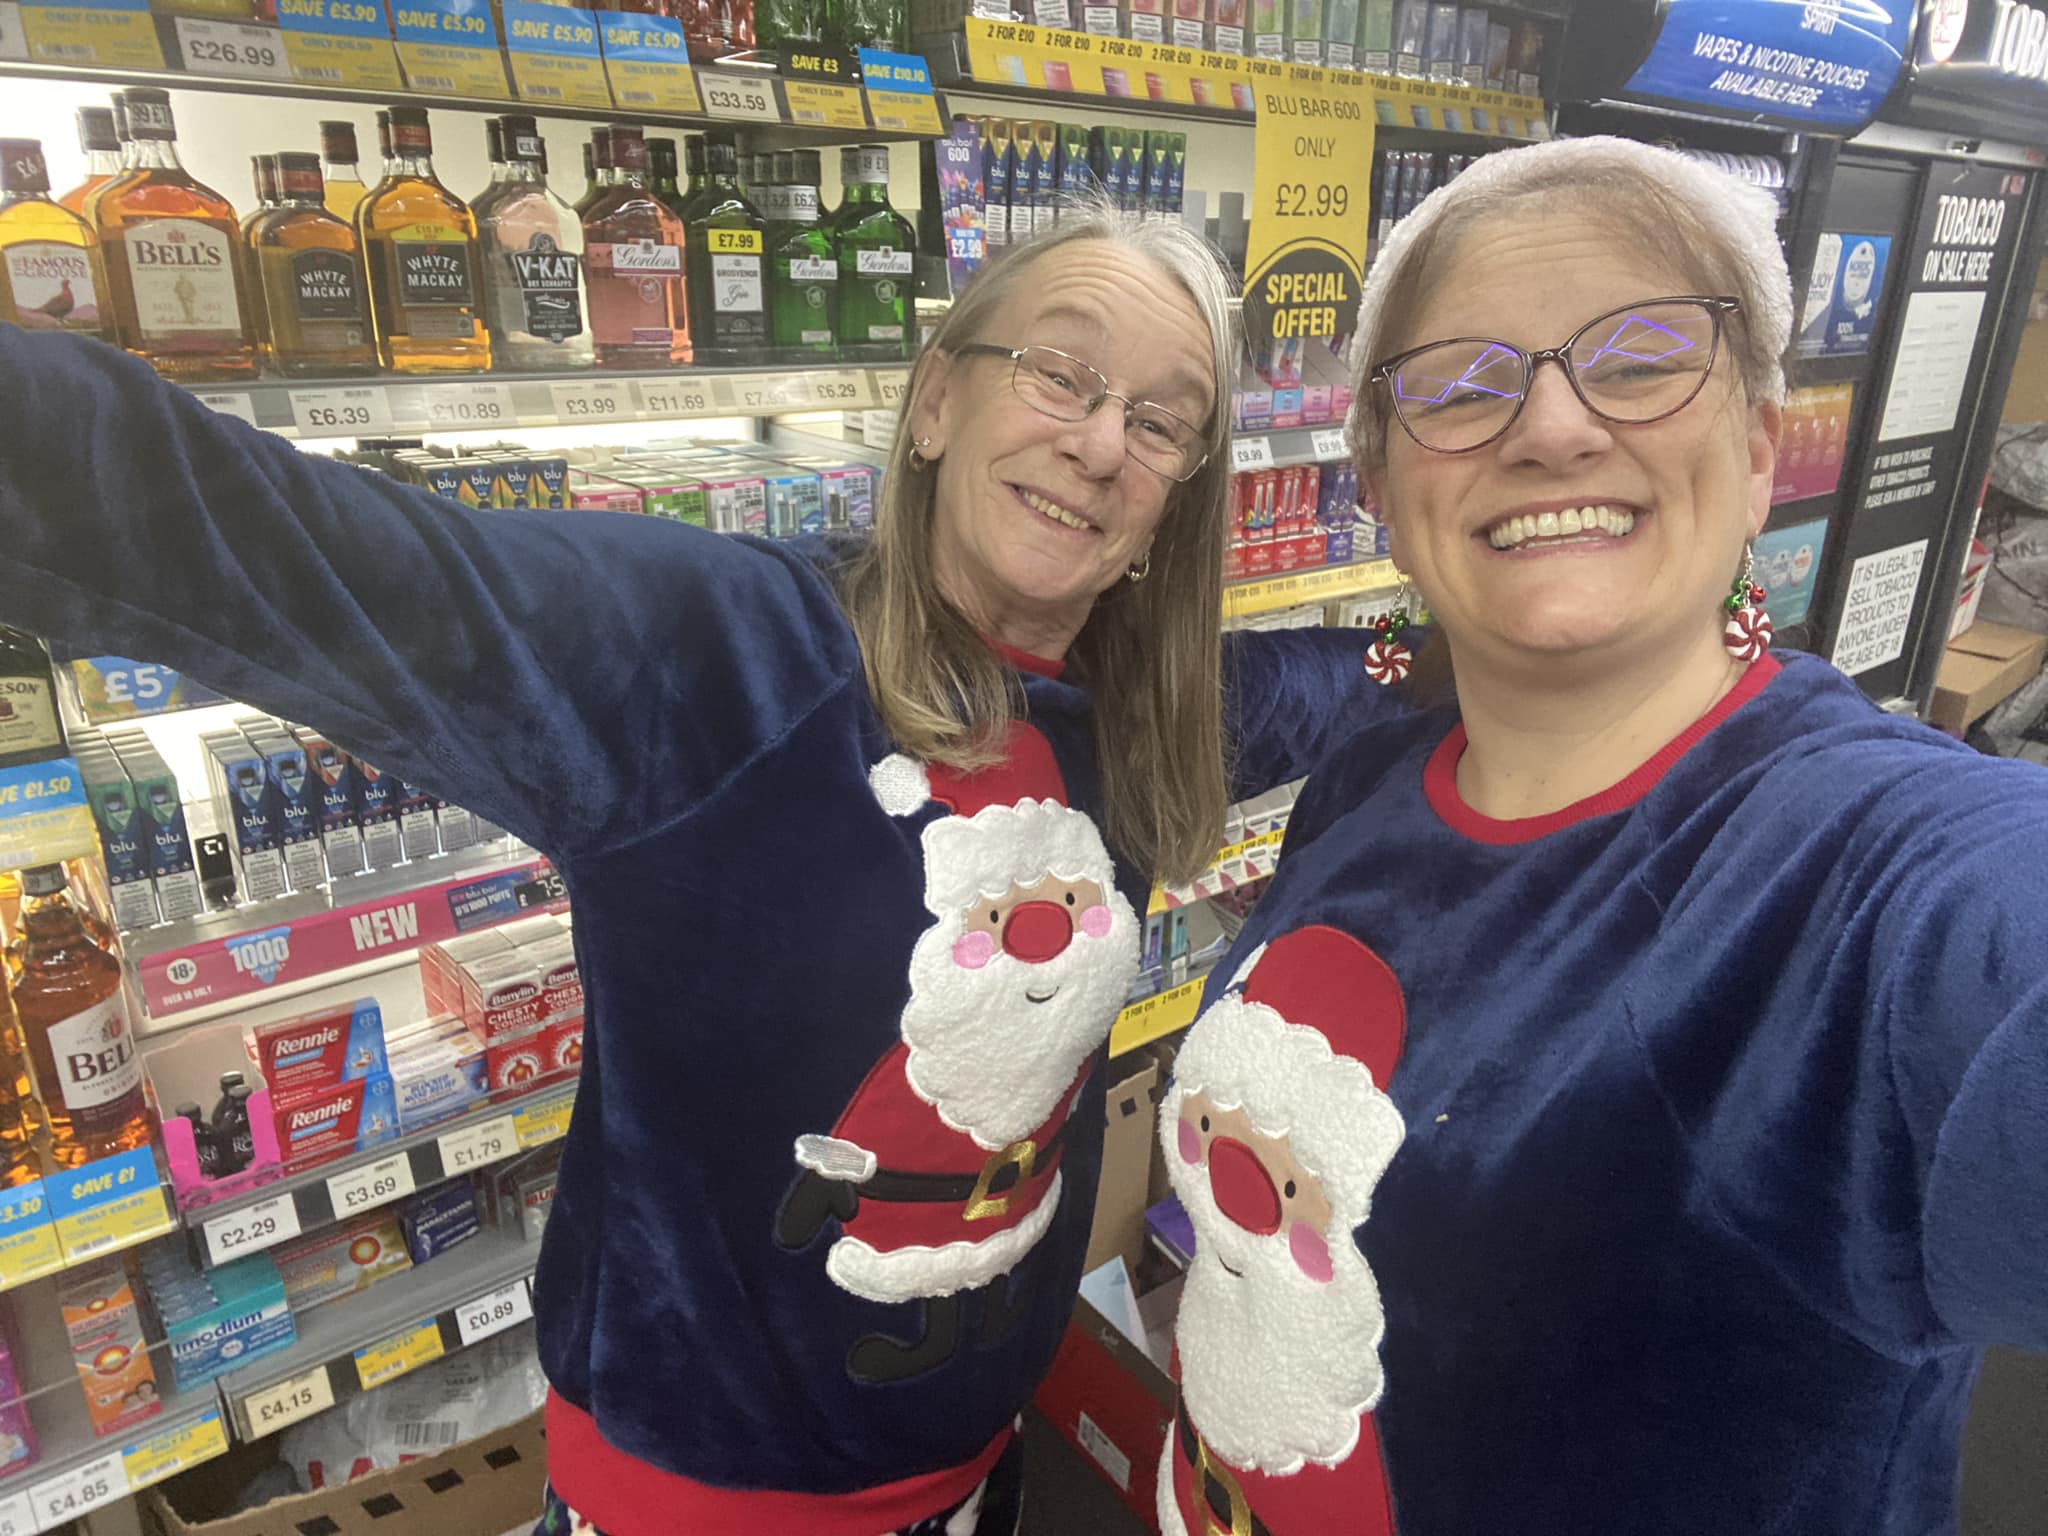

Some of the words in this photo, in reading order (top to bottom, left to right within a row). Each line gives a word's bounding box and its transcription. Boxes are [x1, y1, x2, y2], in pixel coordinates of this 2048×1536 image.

[281, 0, 323, 16] SAVE
[329, 4, 377, 22] £5.90
[397, 10, 437, 29] SAVE
[443, 15, 486, 33] £5.90
[512, 20, 548, 39] SAVE
[553, 23, 593, 42] £5.90
[608, 28, 640, 47] SAVE
[644, 30, 679, 49] £5.90
[996, 26, 1016, 41] FOR
[1018, 28, 1034, 43] £10
[1054, 33, 1071, 48] FOR
[1074, 36, 1089, 51] £10
[1987, 0, 2048, 82] TOB
[190, 40, 276, 67] £26.99
[1109, 41, 1125, 55] FOR
[1160, 49, 1175, 62] FOR
[792, 55, 819, 71] SAVE
[823, 58, 838, 73] £3
[864, 64, 890, 79] SAVE
[1208, 56, 1223, 69] FOR
[1692, 32, 1742, 61] VAPES
[1740, 43, 1751, 66] &
[1753, 45, 1814, 79] NICOTINE
[1812, 60, 1870, 91] POUCHES
[1710, 70, 1786, 101] AVAILABLE
[1783, 85, 1824, 108] HERE
[710, 90, 766, 111] £33.59
[1266, 94, 1297, 116] BLU
[1300, 97, 1332, 118] BAR
[1335, 100, 1360, 120] 600
[948, 148, 970, 161] 600
[1295, 136, 1336, 158] ONLY
[1275, 183, 1348, 217] £2.99
[1932, 194, 2006, 247] TOBACCO
[718, 234, 754, 248] £7.99
[951, 238, 982, 258] £2.99
[22, 255, 85, 269] FAMOUS
[133, 240, 222, 267] BELL'S
[407, 256, 460, 273] WHYTE
[618, 246, 677, 268] Gordon's
[26, 269, 88, 280] GROUSE
[517, 254, 576, 279] V-KAT
[716, 269, 758, 278] GROSVENOR
[1922, 250, 1938, 282] ON
[1938, 251, 1966, 282] SALE
[1963, 252, 1995, 282] HERE
[301, 270, 347, 286] WHYTE
[407, 273, 464, 288] MACKAY
[1265, 272, 1347, 304] SPECIAL
[302, 286, 351, 299] MACKAY
[1272, 307, 1337, 338] OFFER
[817, 383, 857, 399] £6.29
[432, 401, 501, 420] £10.89
[566, 397, 616, 415] £3.99
[649, 395, 705, 412] £11.69
[309, 407, 371, 426] £6.39
[437, 479, 457, 489] blu
[472, 475, 490, 486] blu
[508, 472, 527, 483] blu
[544, 469, 562, 480] blu
[1853, 566, 1863, 585] IT
[1863, 562, 1874, 581] IS
[1874, 553, 1910, 578] ILLEGAL
[1911, 548, 1924, 566] TO
[1849, 585, 1872, 607] SELL
[1875, 571, 1917, 599] TOBACCO
[1846, 600, 1896, 630] PRODUCTS
[1897, 593, 1911, 611] TO
[1837, 624, 1875, 653] ANYONE
[1876, 612, 1907, 638] UNDER
[1855, 645, 1874, 664] AGE
[1875, 639, 1890, 658] OF
[105, 666, 163, 704] £5
[25, 777, 71, 800] £1.50
[325, 793, 347, 805] blu
[366, 789, 386, 800] blu
[243, 815, 267, 828] blu
[285, 806, 308, 818] blu
[111, 841, 136, 854] blu
[156, 833, 180, 846] blu
[350, 902, 419, 951] NEW
[228, 936, 290, 973] 1000
[169, 963, 195, 982] 18+
[491, 984, 536, 1006] Benylin
[488, 1001, 540, 1025] CHESTY
[276, 1028, 339, 1057] Rennie
[291, 1097, 353, 1130] Rennie
[454, 1138, 502, 1166] £1.79
[71, 1172, 113, 1200] SAVE
[118, 1166, 136, 1185] £1
[345, 1176, 396, 1208] £3.69
[220, 1217, 276, 1249] £2.29
[469, 1301, 514, 1331] £0.89
[172, 1310, 264, 1354] Imodium
[260, 1391, 313, 1421] £4.15
[49, 1479, 109, 1517] £4.85
